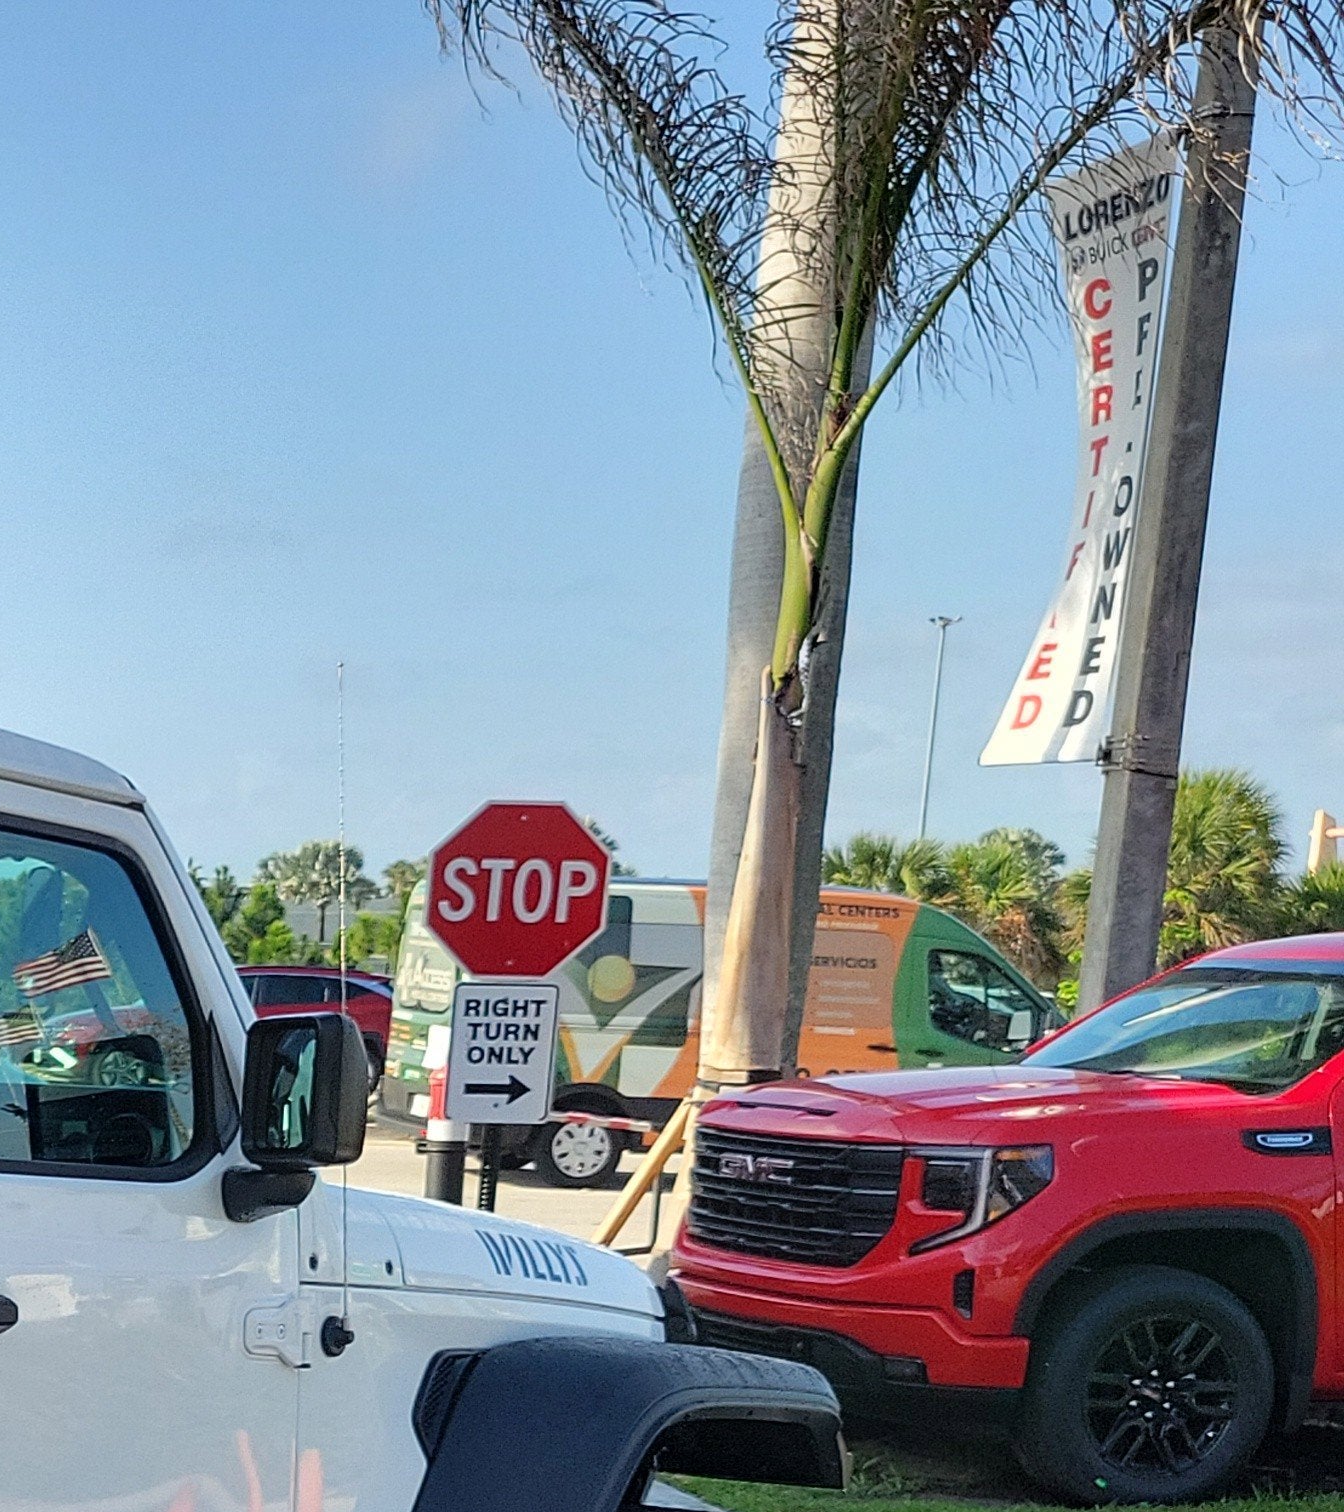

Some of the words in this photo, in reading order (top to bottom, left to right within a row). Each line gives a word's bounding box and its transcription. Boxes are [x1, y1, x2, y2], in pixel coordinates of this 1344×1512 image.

[1064, 173, 1170, 241] LORENZO
[1088, 232, 1129, 264] BUICK
[437, 857, 598, 924] STOP
[838, 905, 900, 919] CENTERS
[464, 998, 547, 1018] RIGHT
[467, 1023, 541, 1042] TURN
[467, 1046, 536, 1065] ONLY
[719, 1152, 794, 1184] GMC
[474, 1229, 588, 1286] WILLYS
